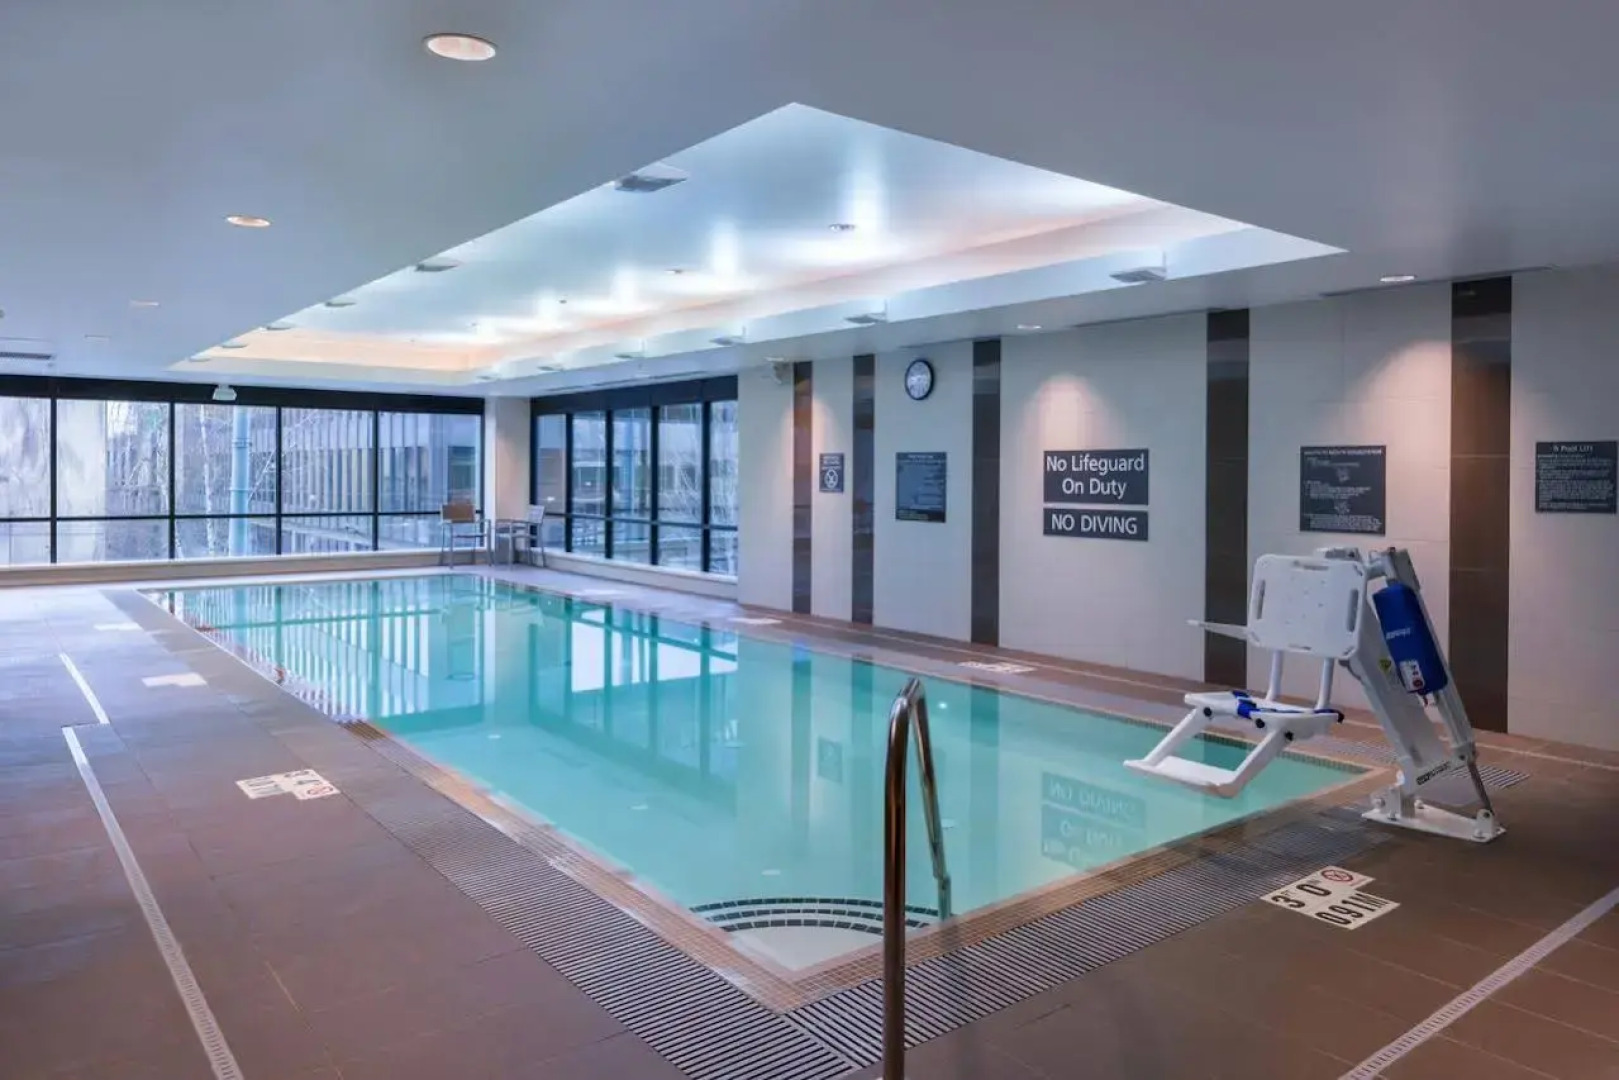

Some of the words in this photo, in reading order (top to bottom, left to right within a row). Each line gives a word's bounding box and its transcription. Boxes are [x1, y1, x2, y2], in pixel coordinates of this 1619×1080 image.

[1046, 455, 1067, 472] No
[1071, 453, 1145, 476] Lifeguard
[1062, 477, 1085, 495] On
[1089, 477, 1127, 500] Duty
[1051, 513, 1075, 532] NO
[1080, 514, 1138, 535] DIVING
[1271, 894, 1306, 909] 3
